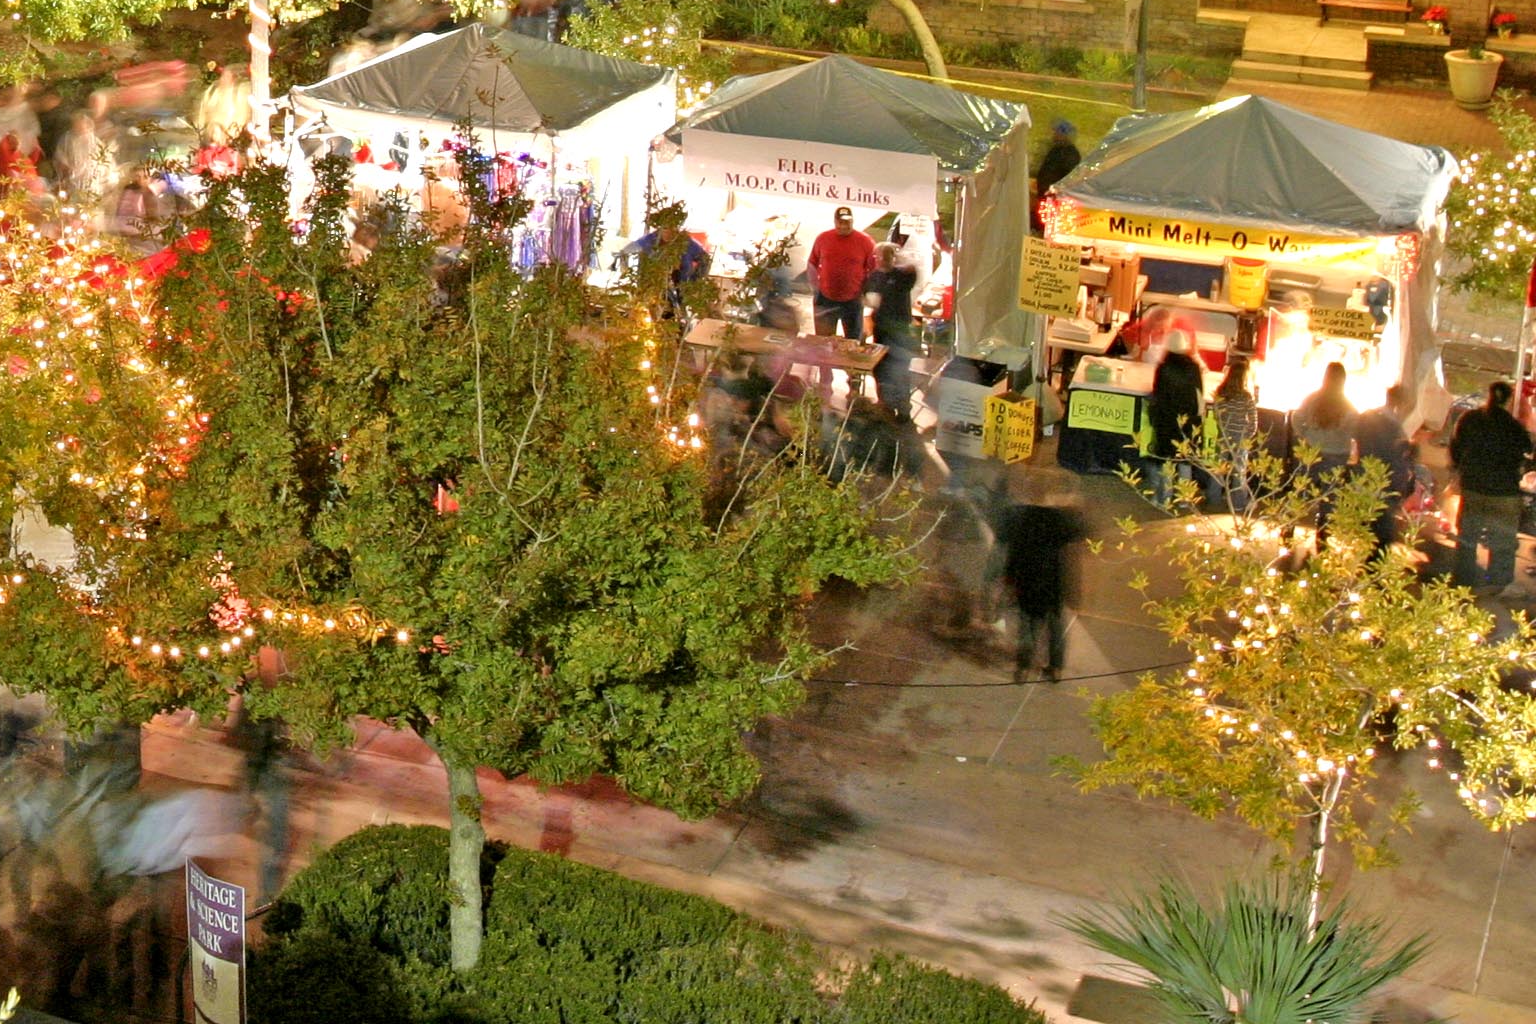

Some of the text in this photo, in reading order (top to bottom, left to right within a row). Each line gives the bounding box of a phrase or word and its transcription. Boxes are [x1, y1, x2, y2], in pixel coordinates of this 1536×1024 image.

[777, 157, 837, 179] F.I.B.C.
[724, 172, 891, 206] M.O.P. Chili & Links
[1108, 216, 1152, 238] Mini
[1334, 310, 1363, 320] CIDER
[1071, 402, 1130, 422] LEMONADE
[190, 867, 236, 908] HERITAGE
[189, 891, 239, 934] & SCIENCE
[198, 923, 223, 953] PARK
